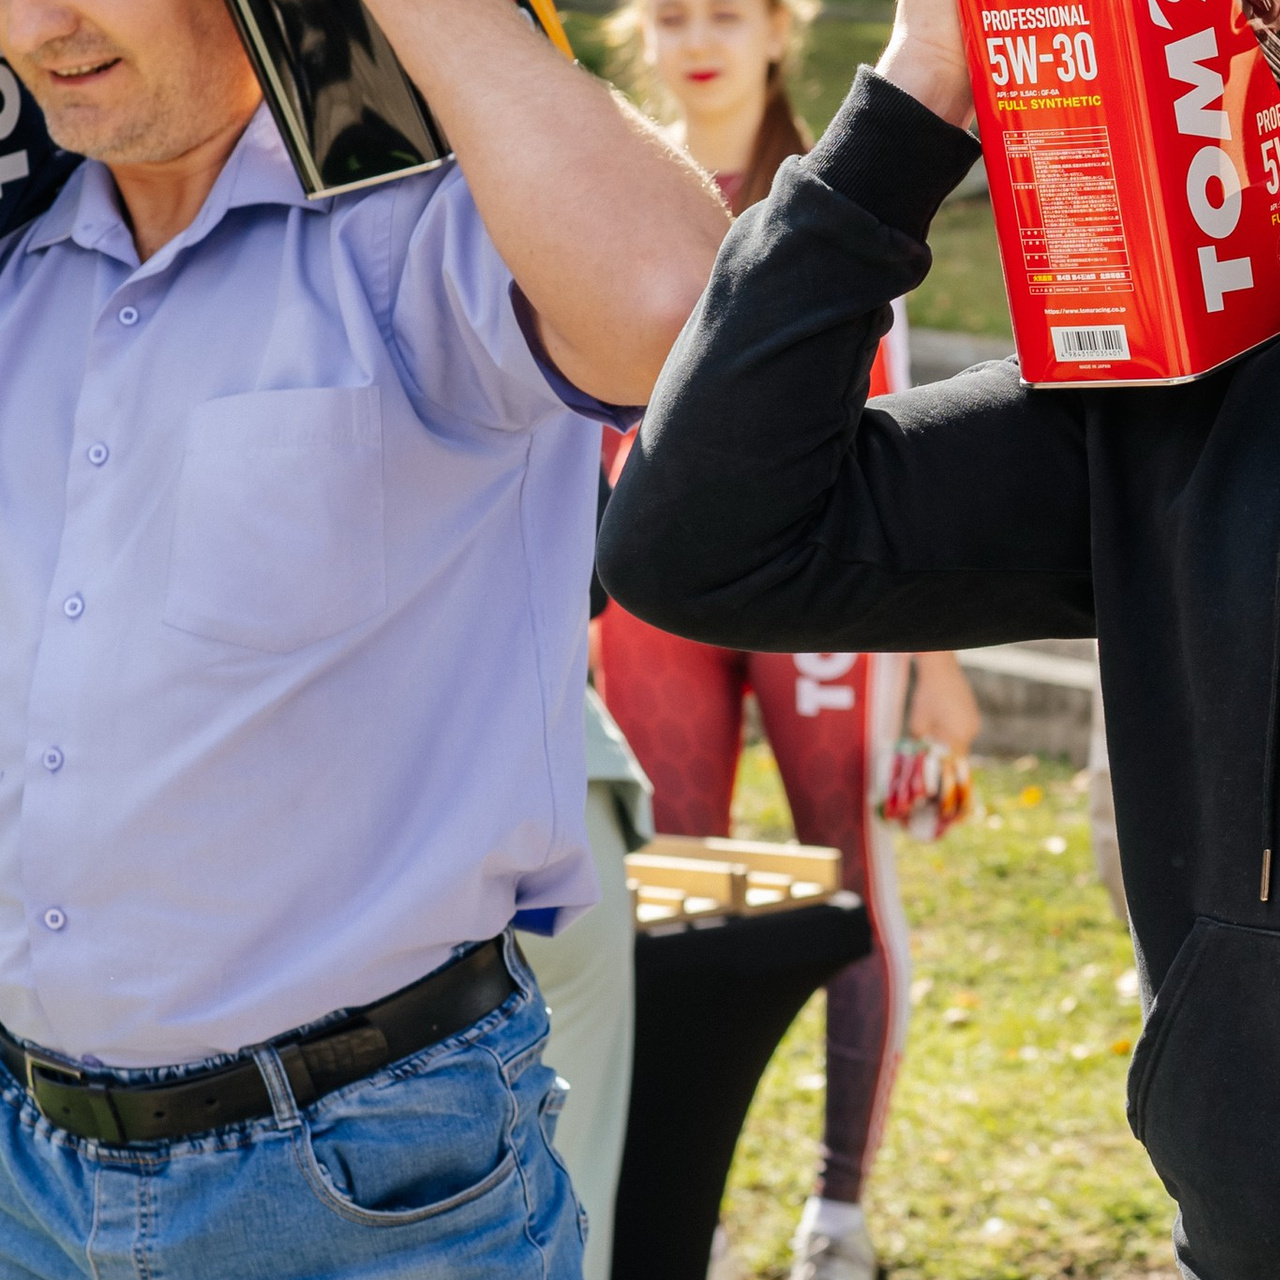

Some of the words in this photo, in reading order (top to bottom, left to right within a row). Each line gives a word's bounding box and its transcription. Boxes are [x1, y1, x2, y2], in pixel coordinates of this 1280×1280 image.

[982, 4, 1090, 32] PROFESSIONAL
[986, 31, 1098, 86] 5W-30
[998, 100, 1027, 111] FULL
[1031, 95, 1102, 109] SYNTHETIC
[1044, 306, 1126, 315] https://www.tomsracing.co.jp
